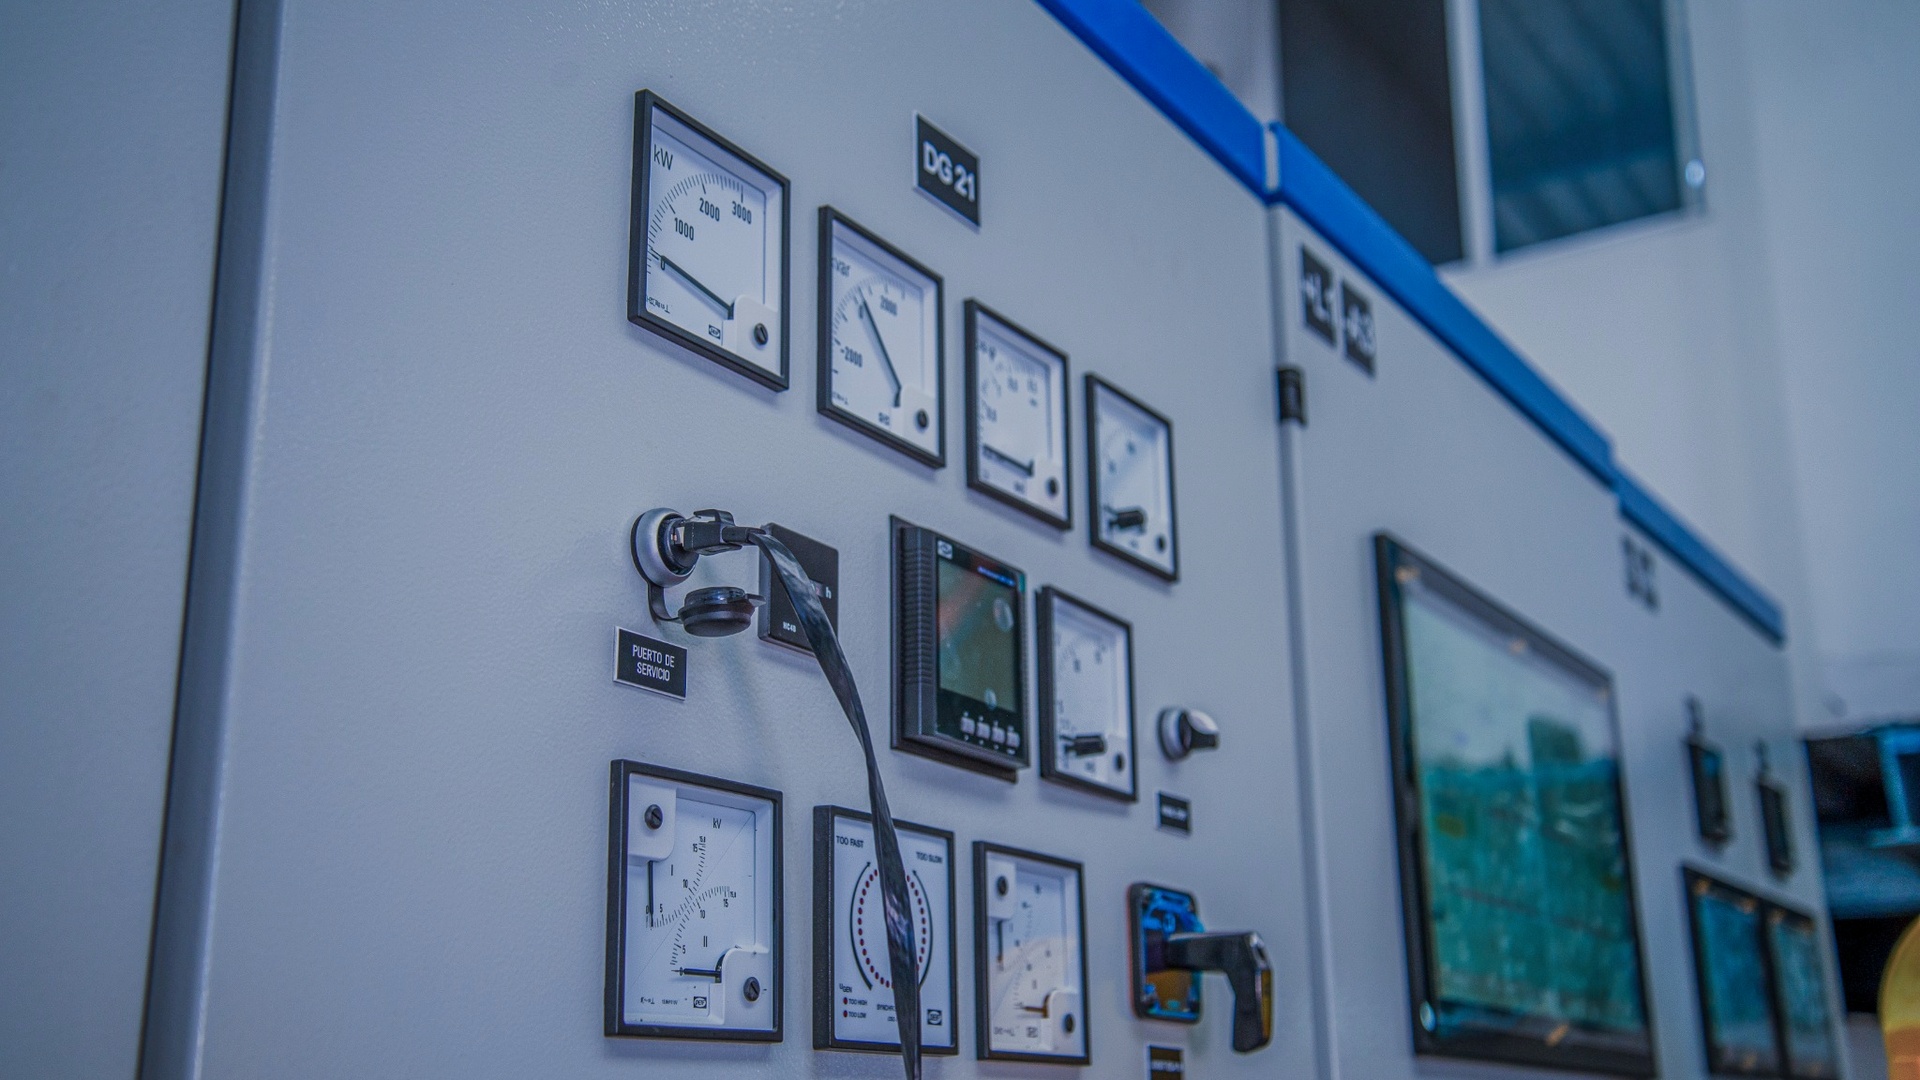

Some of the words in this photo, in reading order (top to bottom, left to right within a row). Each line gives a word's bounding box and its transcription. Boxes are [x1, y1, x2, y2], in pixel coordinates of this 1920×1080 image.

[653, 144, 673, 171] kW
[923, 141, 952, 185] DG
[954, 164, 976, 202] 21
[699, 197, 720, 222] 2000
[731, 201, 752, 225] 3000
[674, 217, 694, 241] 1000
[825, 586, 831, 599] h
[632, 644, 662, 664] PUERTO
[665, 654, 675, 668] DE
[636, 662, 670, 681] SERVICIO
[712, 817, 721, 829] kV
[836, 836, 849, 846] TOO
[850, 838, 864, 848] FAST
[916, 851, 927, 861] TOO
[660, 903, 664, 913] 5
[723, 899, 729, 908] 15
[700, 909, 706, 919] 10
[682, 944, 686, 955] 5
